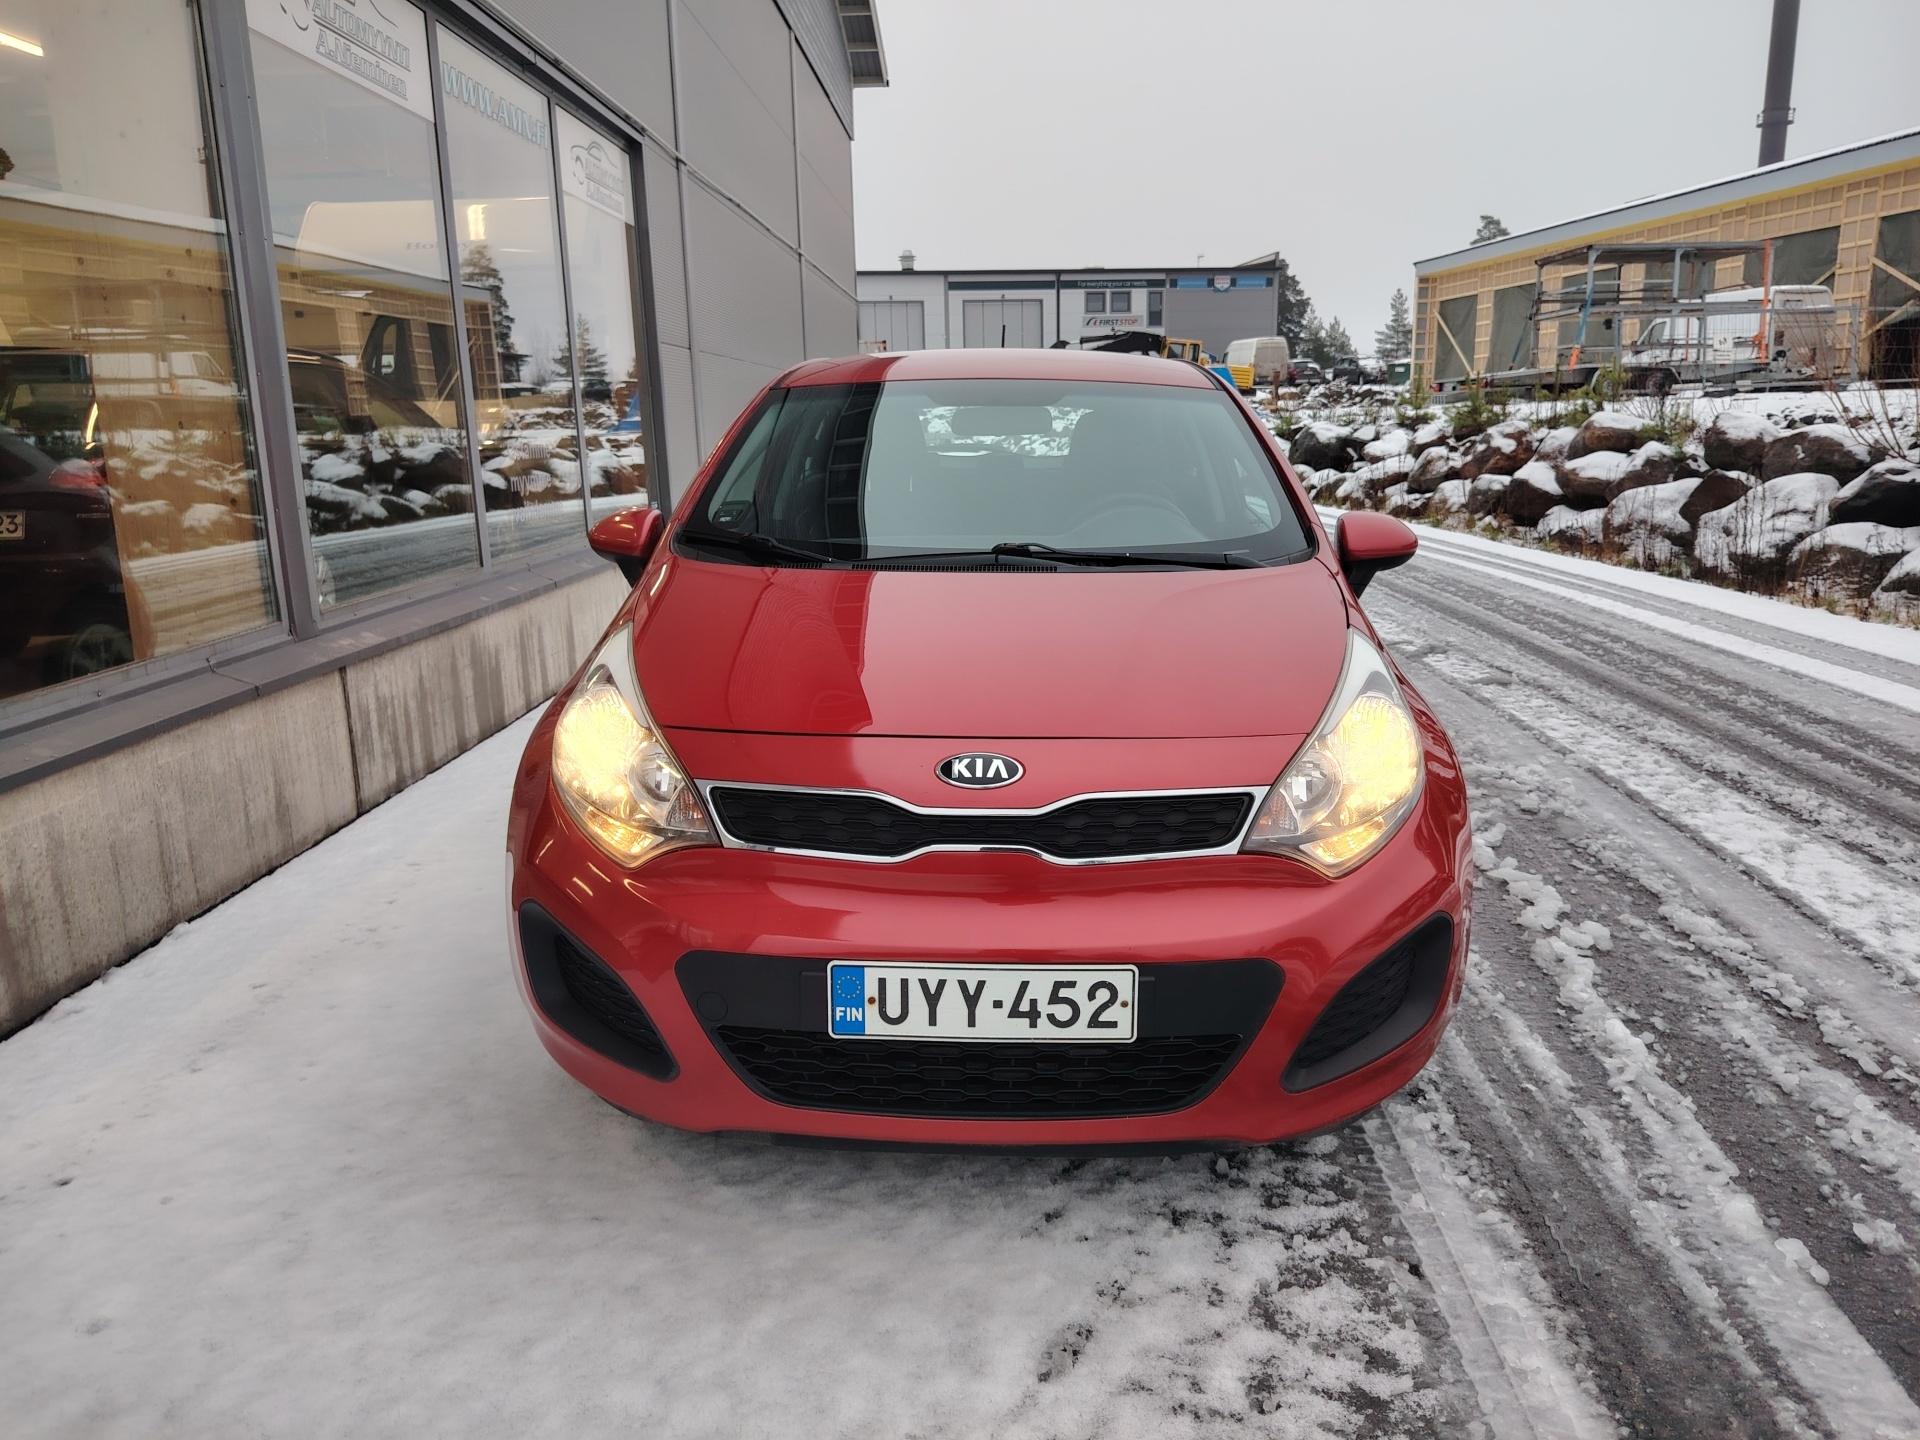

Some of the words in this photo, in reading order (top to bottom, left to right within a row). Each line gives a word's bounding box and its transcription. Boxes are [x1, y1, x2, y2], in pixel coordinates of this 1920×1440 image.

[312, 0, 410, 68] AUTOMYYNTI
[441, 61, 549, 150] WWW.AMN.FI
[951, 757, 1009, 779] KIA
[835, 1006, 863, 1022] FIN
[877, 977, 1119, 1030] UYY-452
